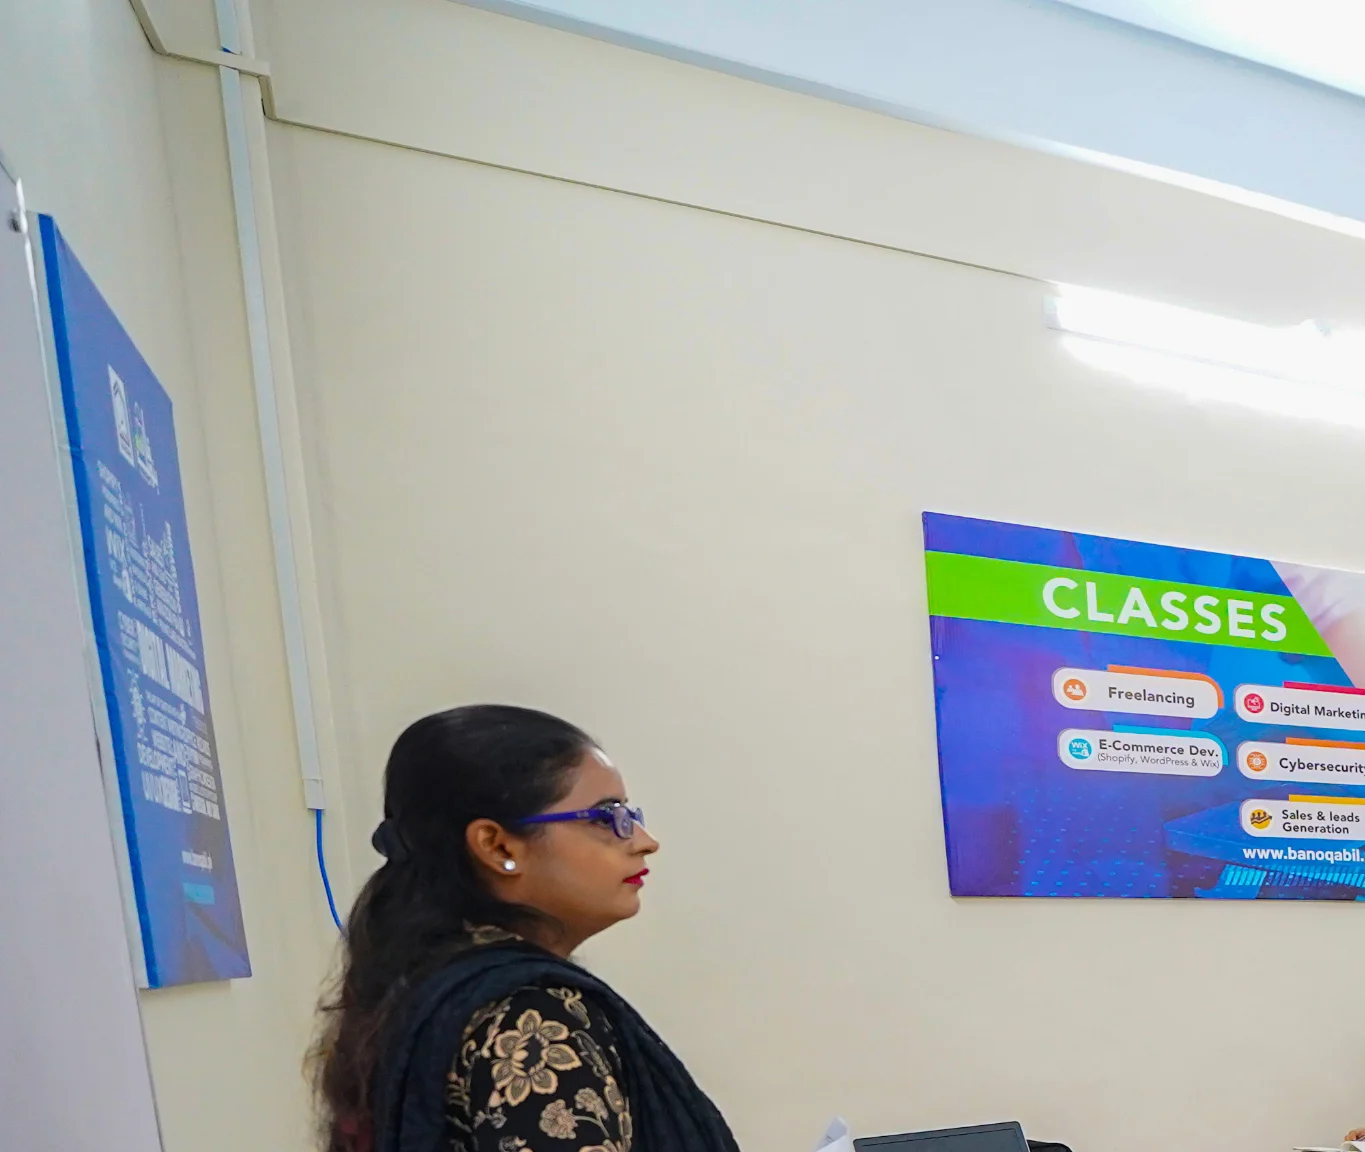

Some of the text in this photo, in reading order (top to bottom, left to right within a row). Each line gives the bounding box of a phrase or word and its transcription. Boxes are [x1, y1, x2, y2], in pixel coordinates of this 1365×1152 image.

[1042, 577, 1287, 642] CLASSES
[1108, 687, 1195, 708] Freelancing
[1270, 702, 1310, 722] Digital
[1099, 739, 1219, 757] E-Commerce Dev.
[1097, 752, 1220, 769] (Shopify, WordPress & Wix)
[1281, 810, 1360, 823] Sales & leads
[1282, 822, 1349, 835] Generation
